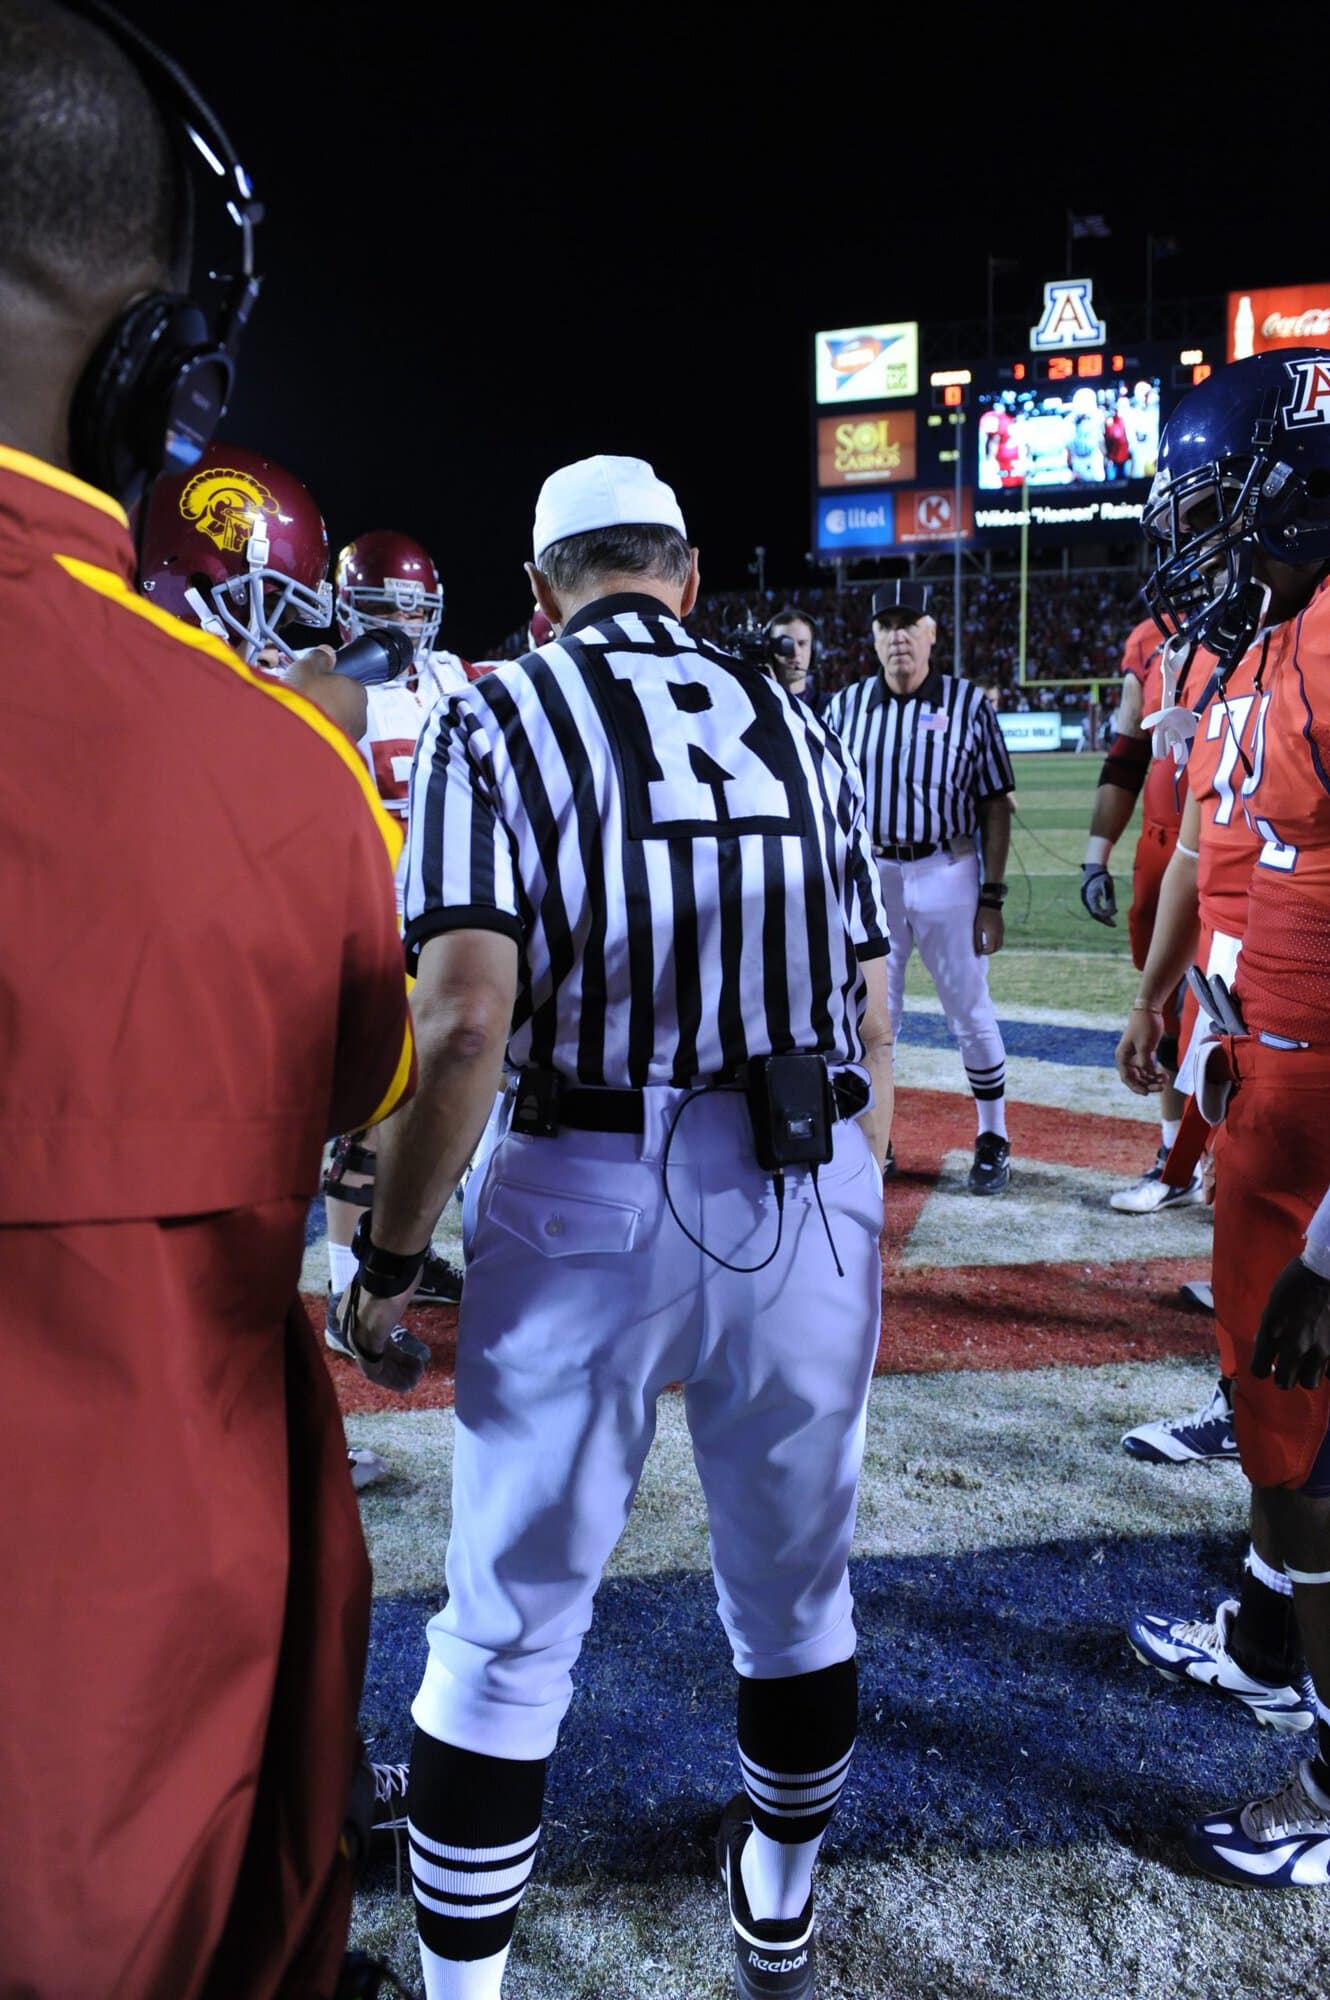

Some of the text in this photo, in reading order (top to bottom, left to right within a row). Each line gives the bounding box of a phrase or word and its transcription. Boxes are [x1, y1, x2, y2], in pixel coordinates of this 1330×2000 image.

[1030, 278, 1106, 352] A
[603, 651, 791, 824] R
[748, 1949, 808, 1973] Reebok
